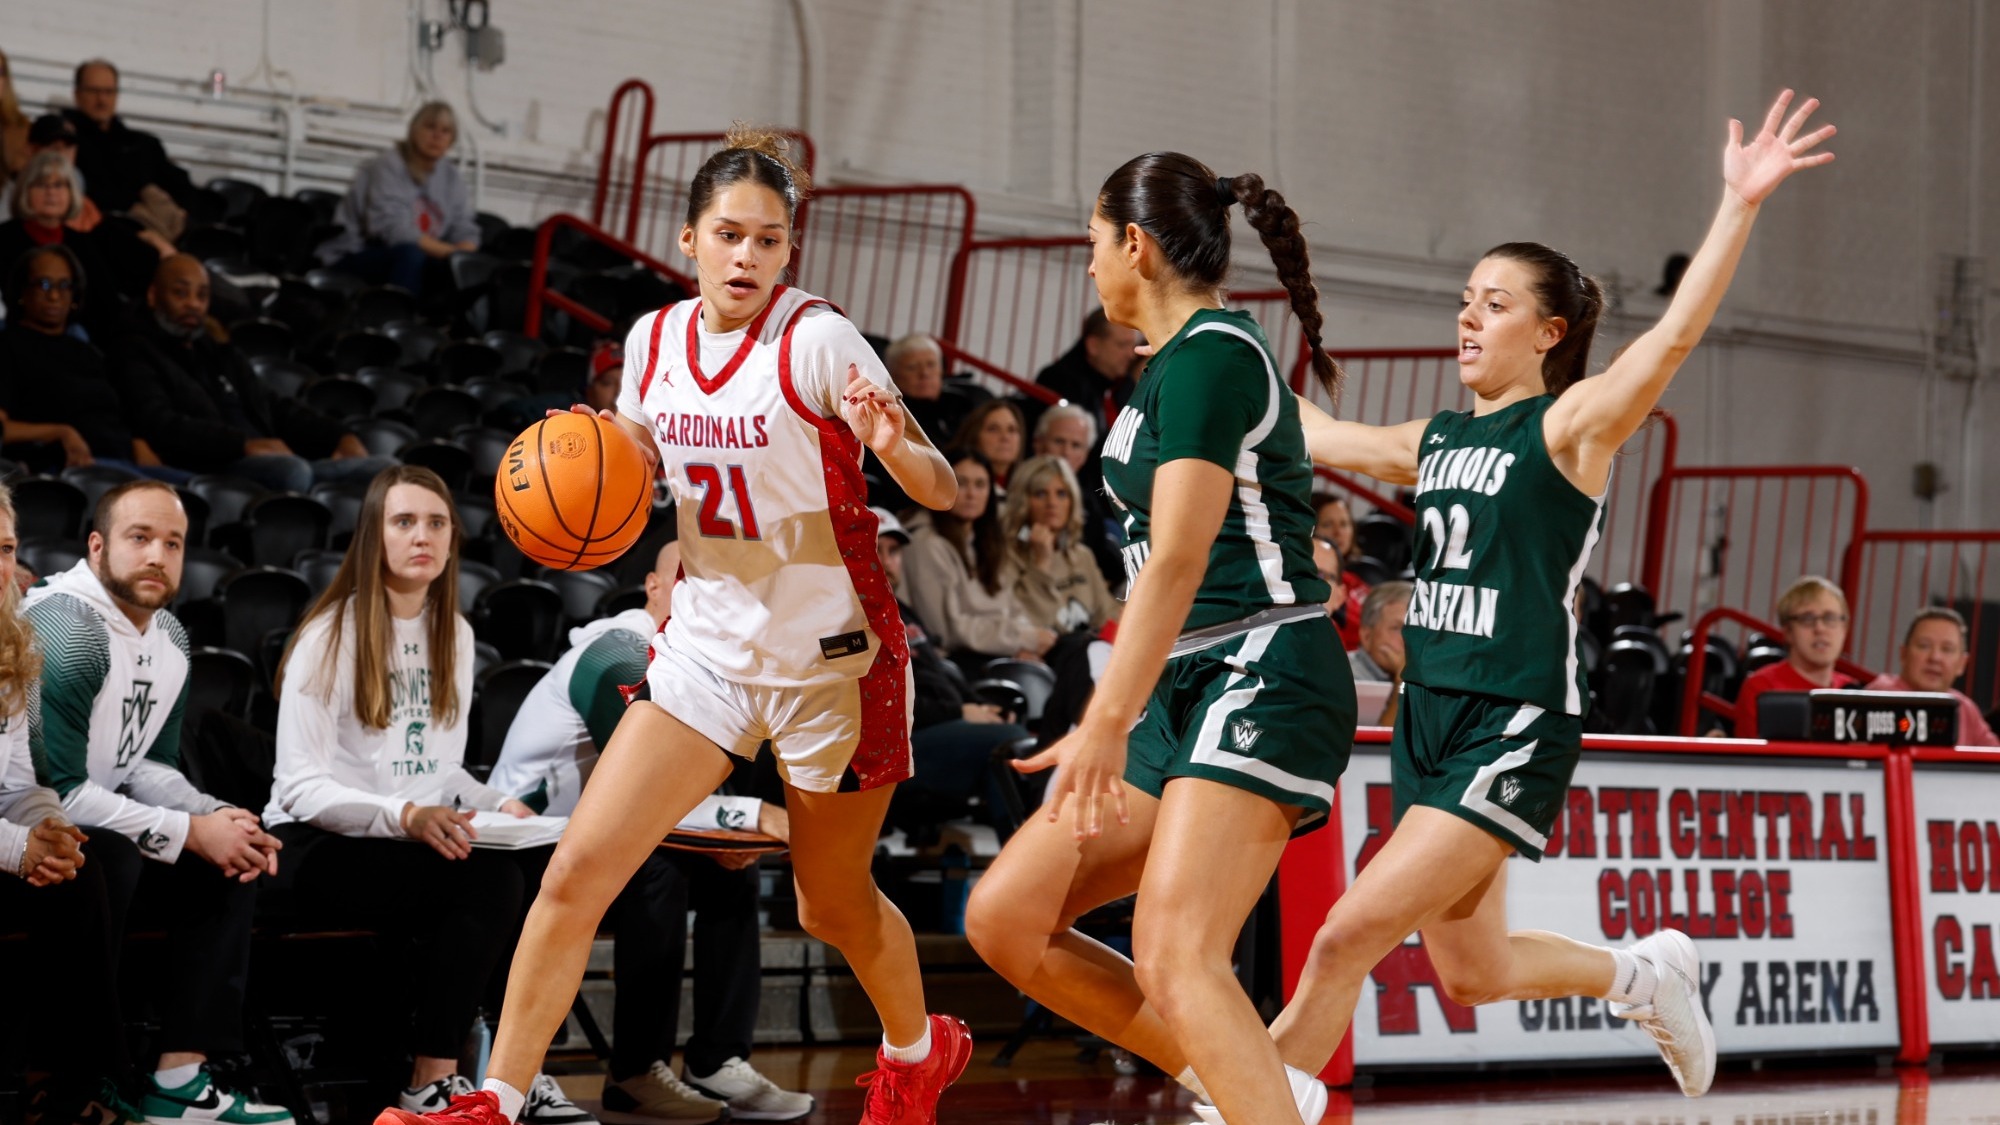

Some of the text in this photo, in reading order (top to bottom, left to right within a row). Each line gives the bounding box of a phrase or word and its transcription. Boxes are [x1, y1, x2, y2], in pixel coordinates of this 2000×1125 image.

[655, 412, 769, 449] CARDINALS
[683, 462, 762, 541] 21
[1404, 577, 1499, 638] ESLEYAN
[1668, 788, 1878, 861] CENTRAL
[1598, 868, 1795, 939] COLLEGE
[1735, 960, 1880, 1026] ARENA
